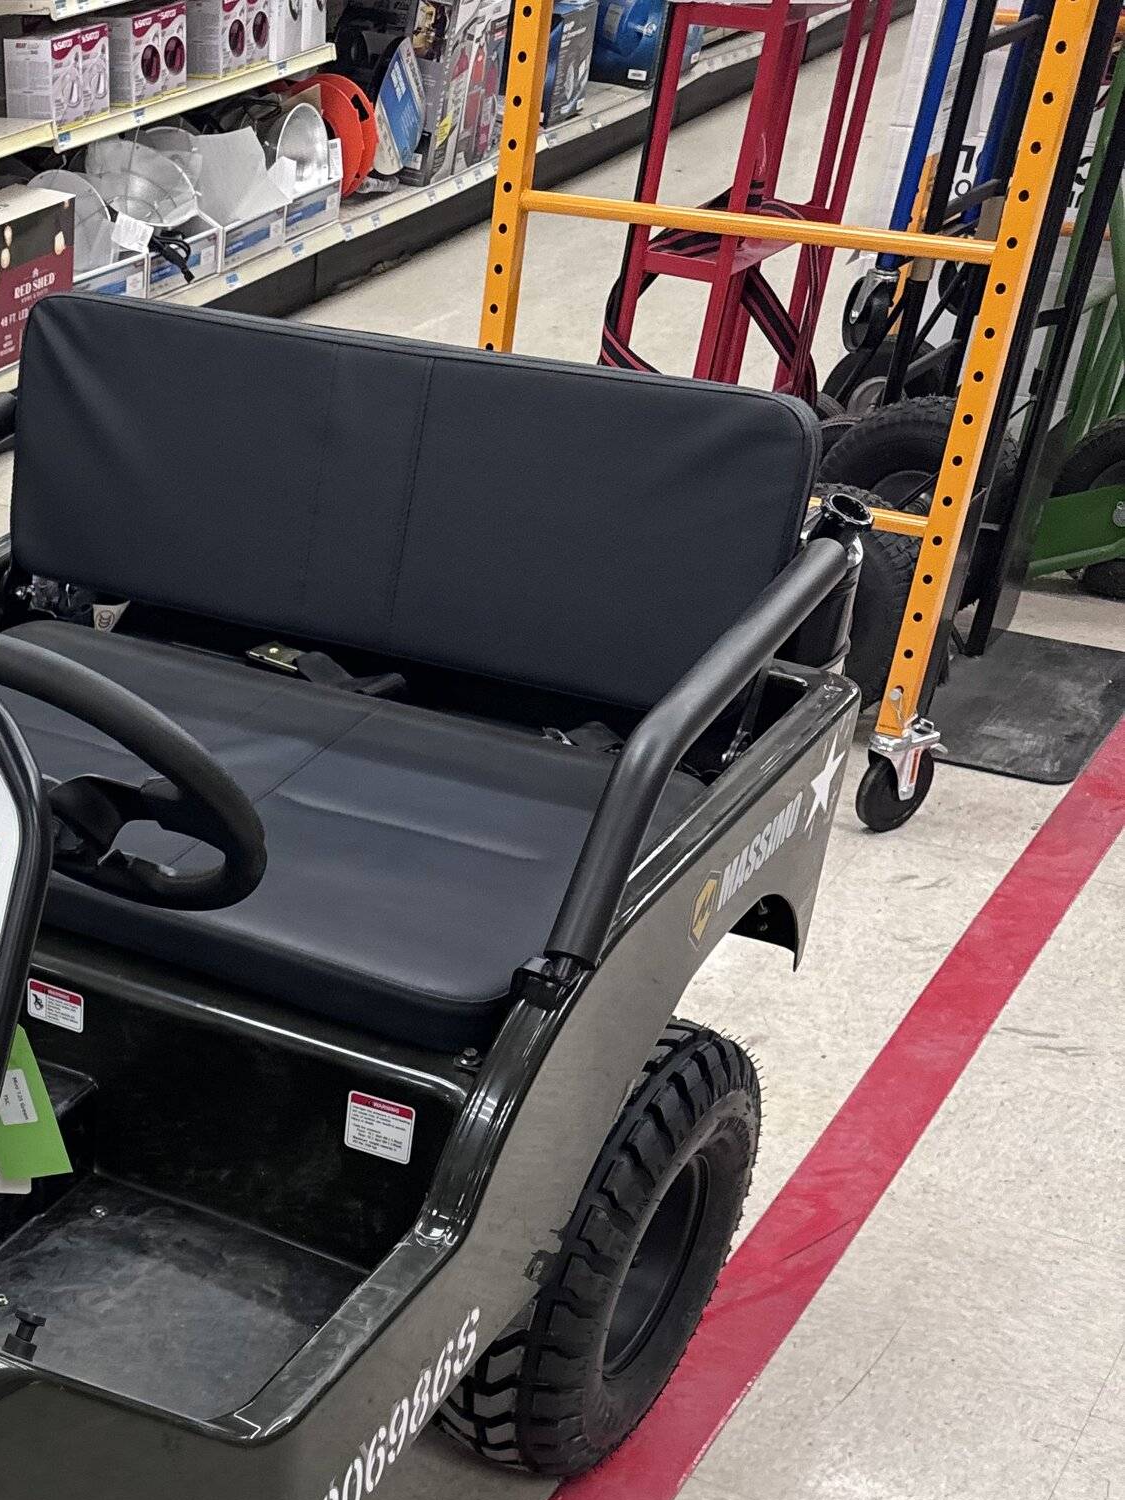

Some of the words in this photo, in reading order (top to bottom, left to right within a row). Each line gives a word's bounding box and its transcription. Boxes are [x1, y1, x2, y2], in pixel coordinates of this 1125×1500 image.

[14, 279, 32, 299] RED
[32, 272, 55, 291] SHED
[716, 791, 803, 912] MASSIMO
